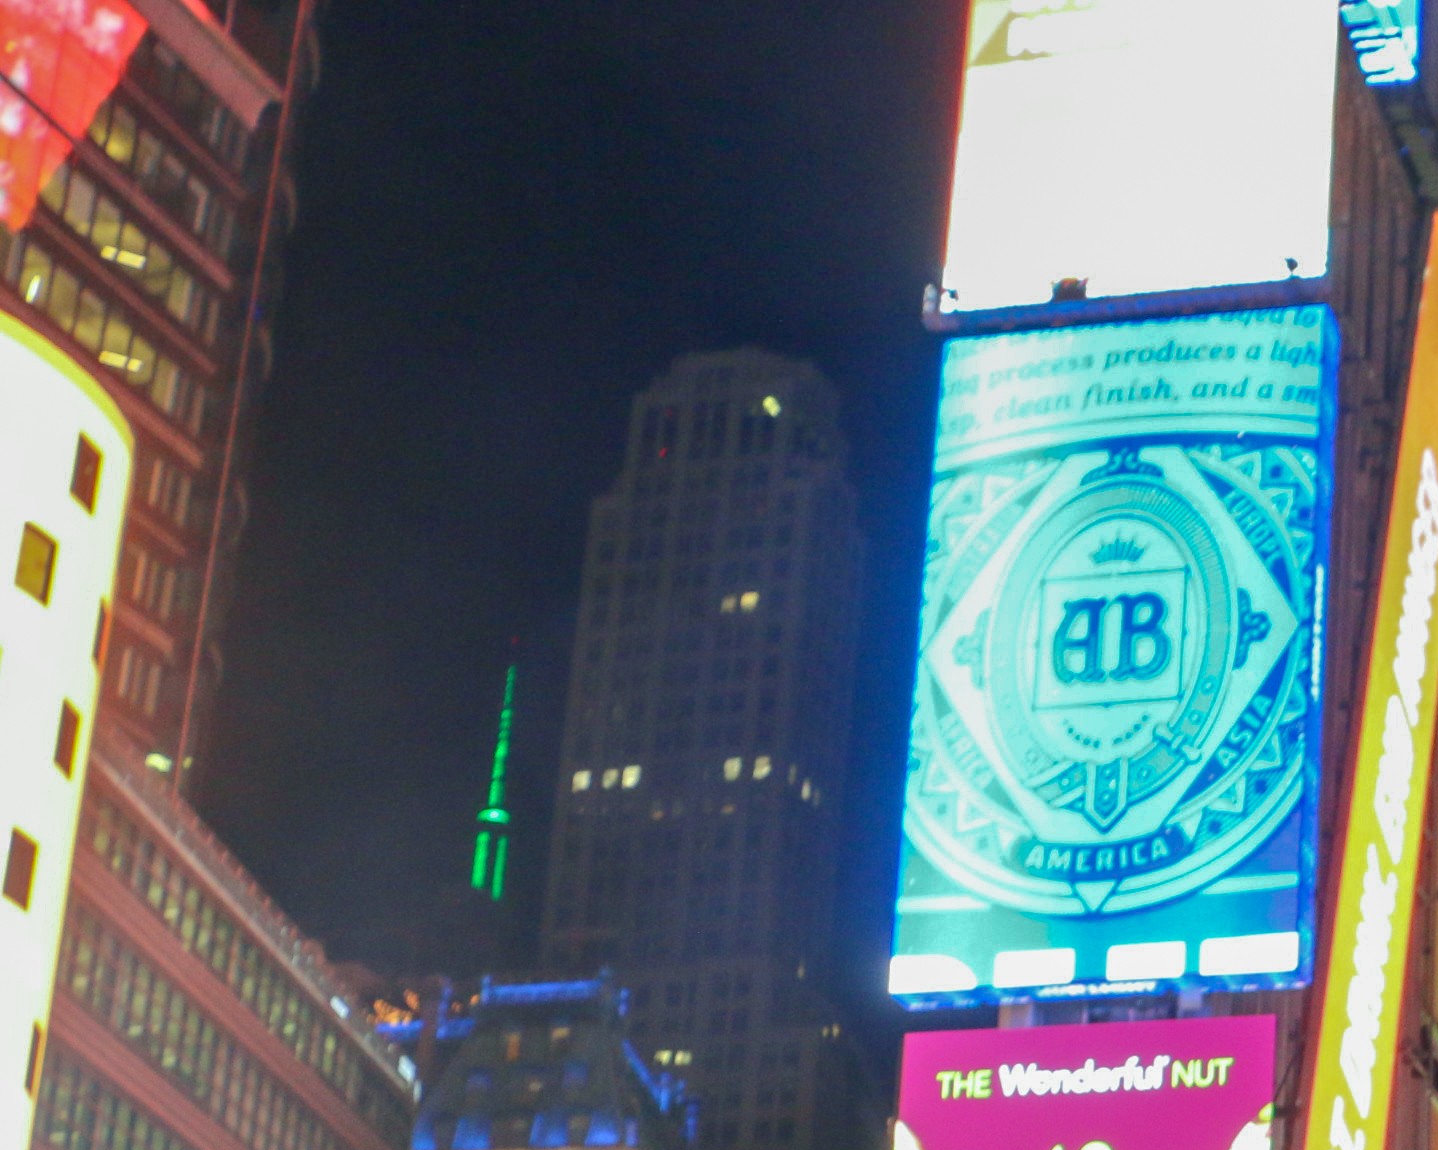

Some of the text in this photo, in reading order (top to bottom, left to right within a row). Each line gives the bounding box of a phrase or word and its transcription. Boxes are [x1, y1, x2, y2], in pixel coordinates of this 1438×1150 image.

[987, 353, 1096, 387] process
[1103, 340, 1235, 370] produces
[1245, 344, 1261, 361] a
[993, 390, 1072, 418] clean
[1081, 378, 1179, 410] finish,
[1191, 376, 1250, 400] and
[1256, 382, 1274, 400] a
[1217, 695, 1276, 768] ASIA
[1024, 834, 1171, 871] AMERICA
[935, 1054, 1235, 1100] THE Wonderful NUT
